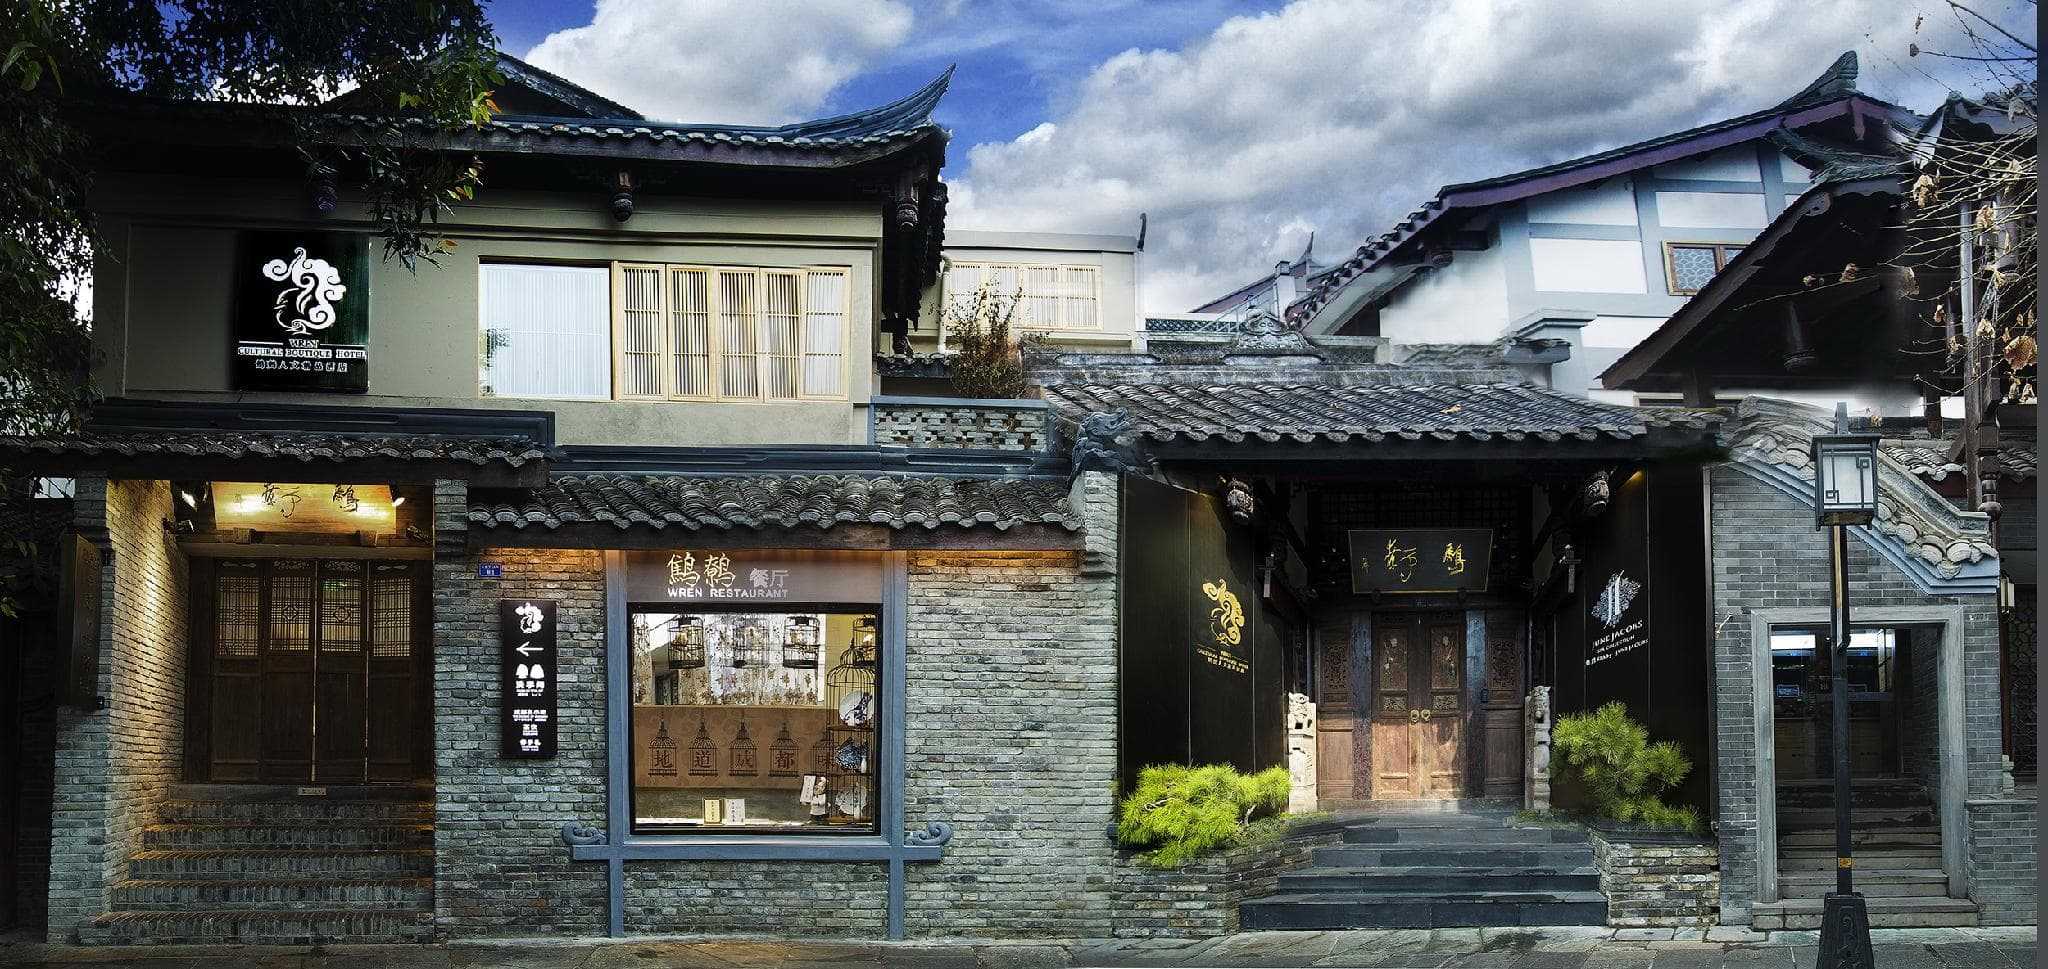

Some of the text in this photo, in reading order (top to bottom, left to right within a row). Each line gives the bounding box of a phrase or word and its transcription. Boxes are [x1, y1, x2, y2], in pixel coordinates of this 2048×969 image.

[336, 349, 366, 360] HOTEL
[667, 588, 789, 598] WREN RESTAURANT
